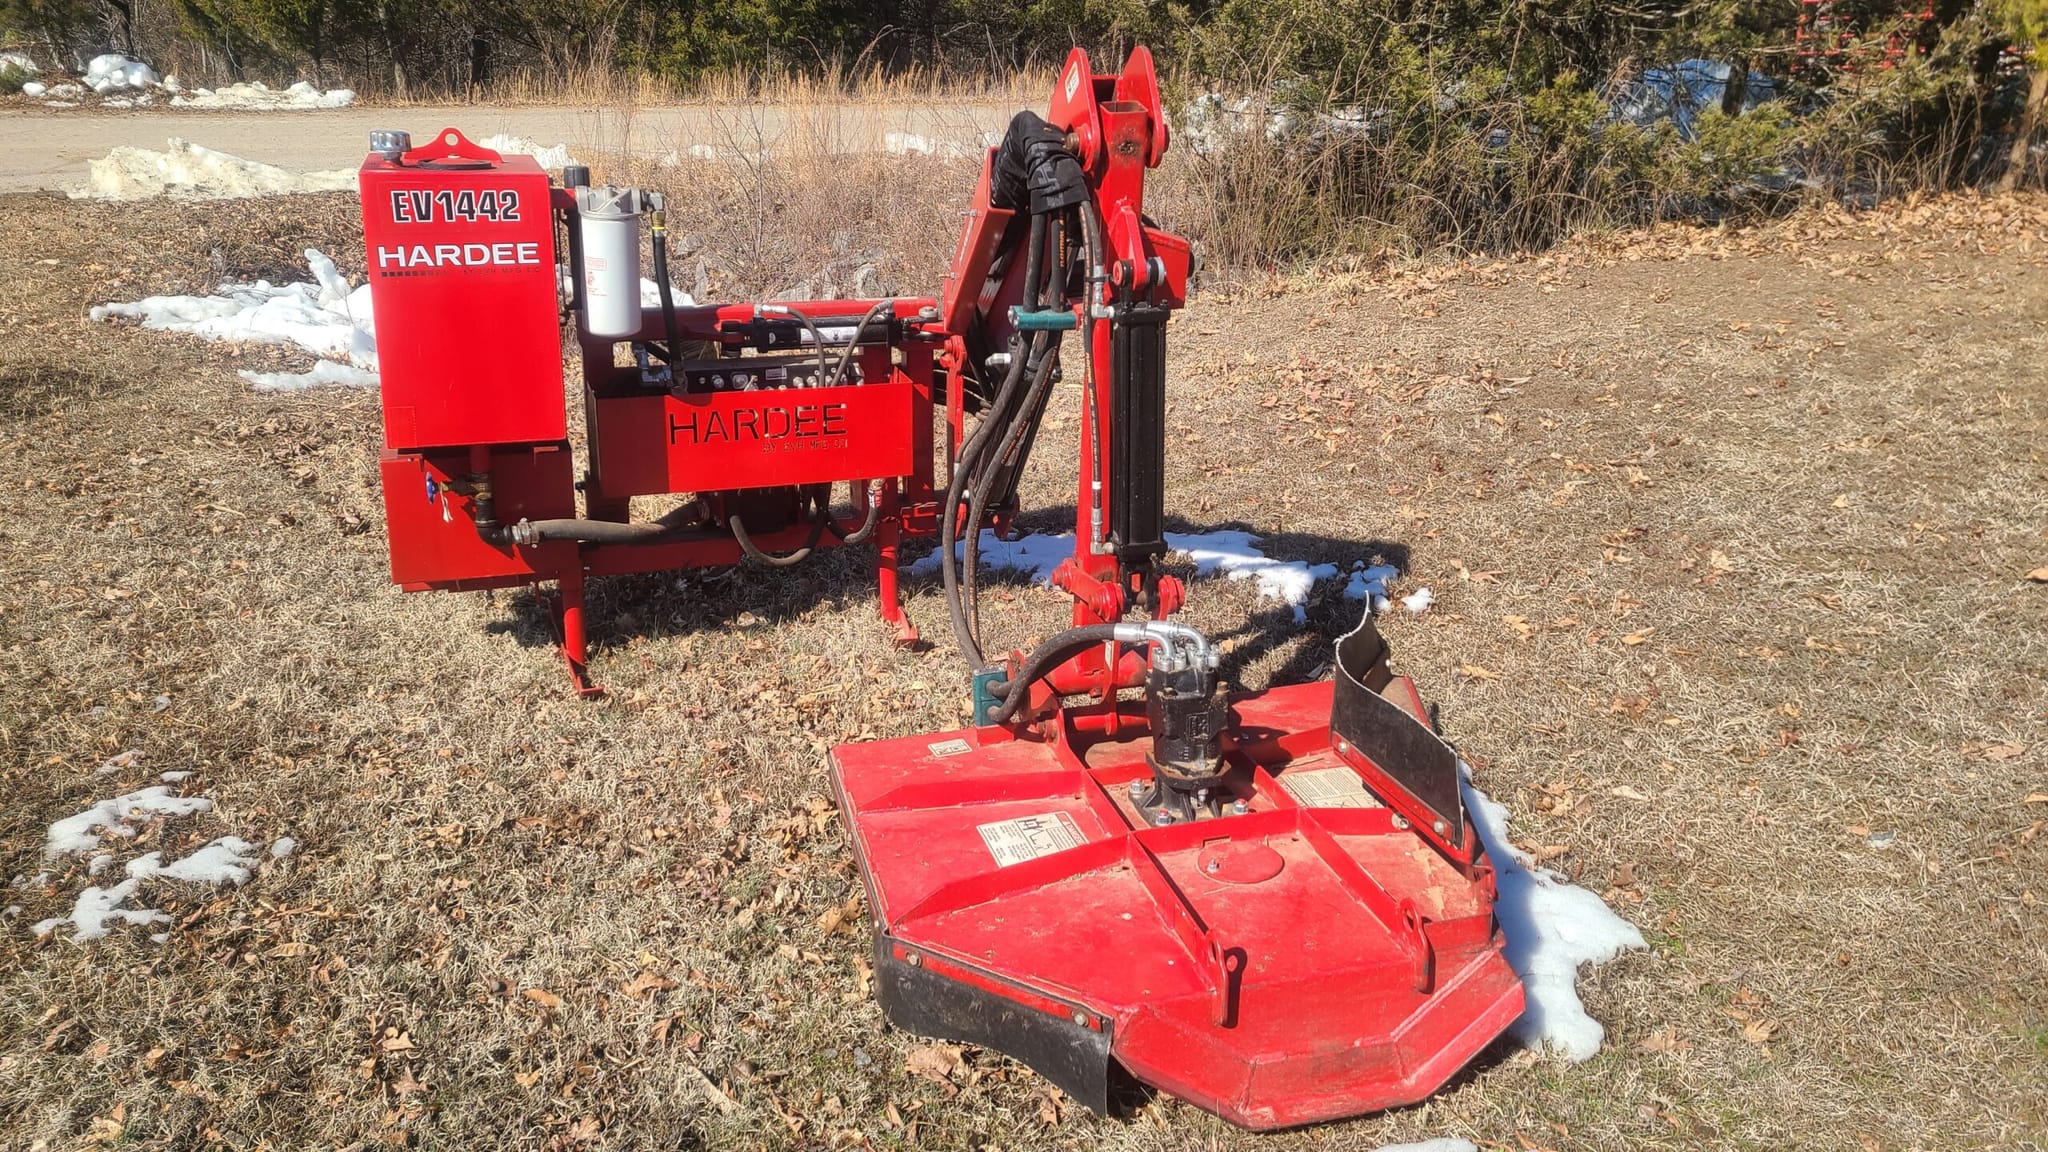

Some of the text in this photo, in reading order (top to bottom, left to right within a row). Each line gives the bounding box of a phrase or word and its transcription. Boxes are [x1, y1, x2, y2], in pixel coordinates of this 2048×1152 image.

[391, 190, 521, 223] EV1442
[377, 243, 540, 268] HARDEE
[669, 403, 848, 445] HARDEE
